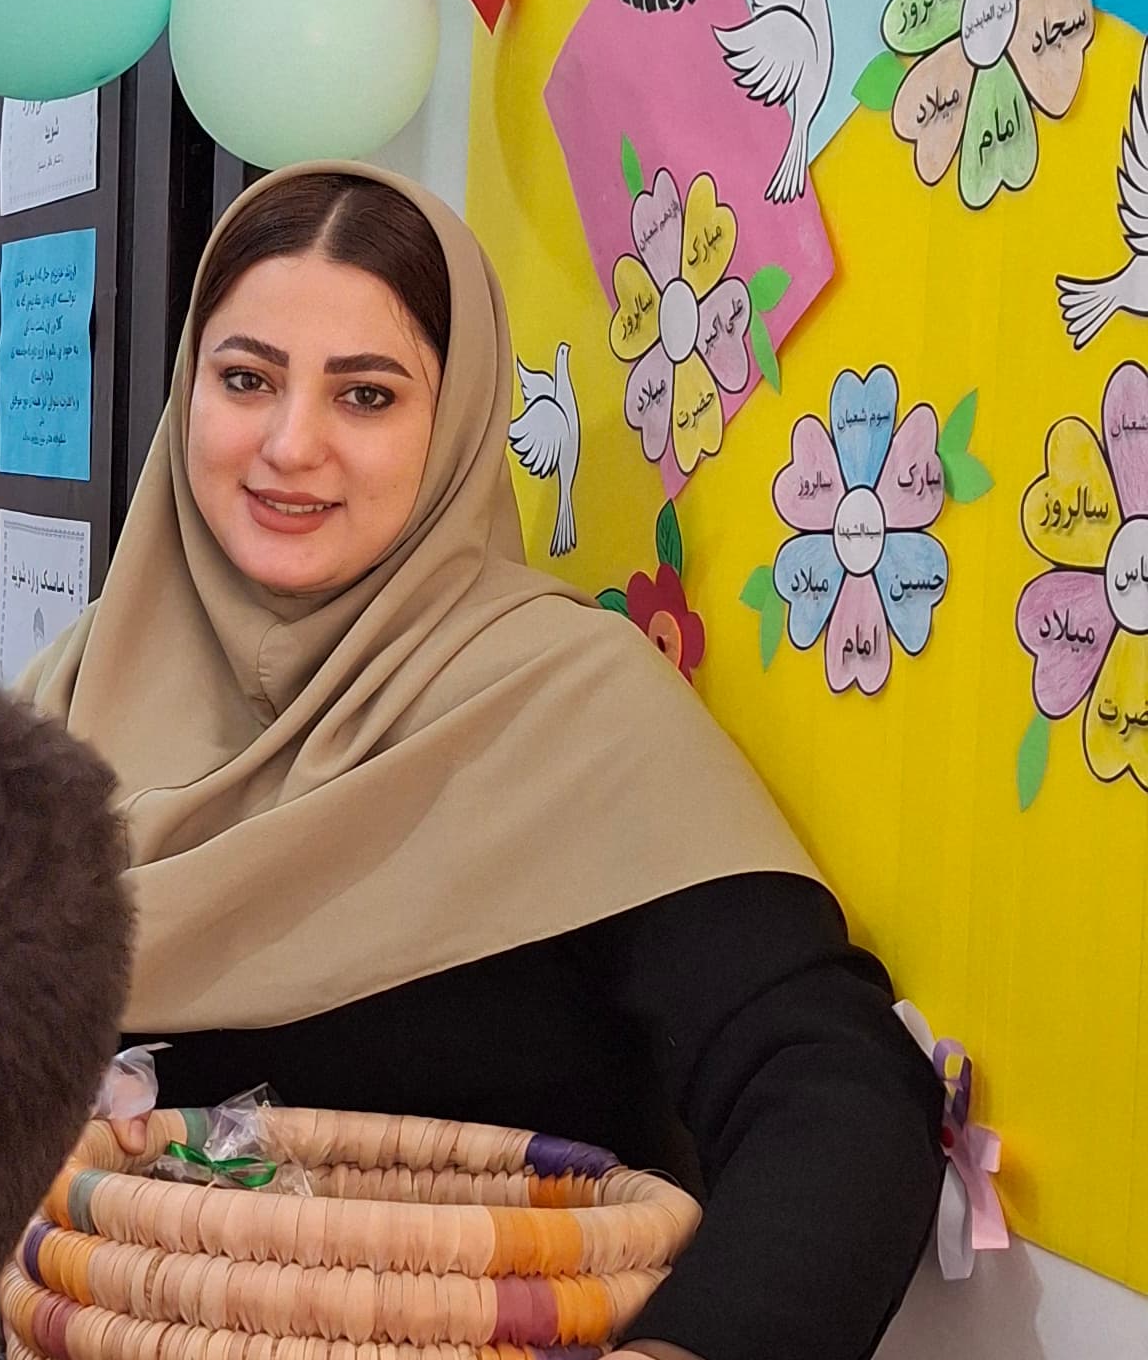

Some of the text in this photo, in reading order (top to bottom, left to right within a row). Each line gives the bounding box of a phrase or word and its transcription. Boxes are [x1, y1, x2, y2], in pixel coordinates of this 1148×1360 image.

[1031, 9, 1087, 54] سجاد
[916, 85, 961, 124] میلاد
[977, 96, 1022, 167] امام
[687, 225, 722, 266] مبارک
[621, 292, 653, 340] سالروز
[704, 313, 723, 355] اکبر
[636, 378, 667, 412] میلاد
[676, 391, 715, 429] حضرت
[837, 408, 891, 430] سوم شعبان
[797, 470, 833, 497] سالروز
[897, 461, 941, 496] بارک
[1040, 485, 1109, 529] سالروز
[791, 565, 829, 601] میلاد
[889, 573, 945, 602] حسین
[842, 624, 878, 665] امام
[1039, 608, 1096, 653] میلاد
[1097, 698, 1148, 736] ضرت
